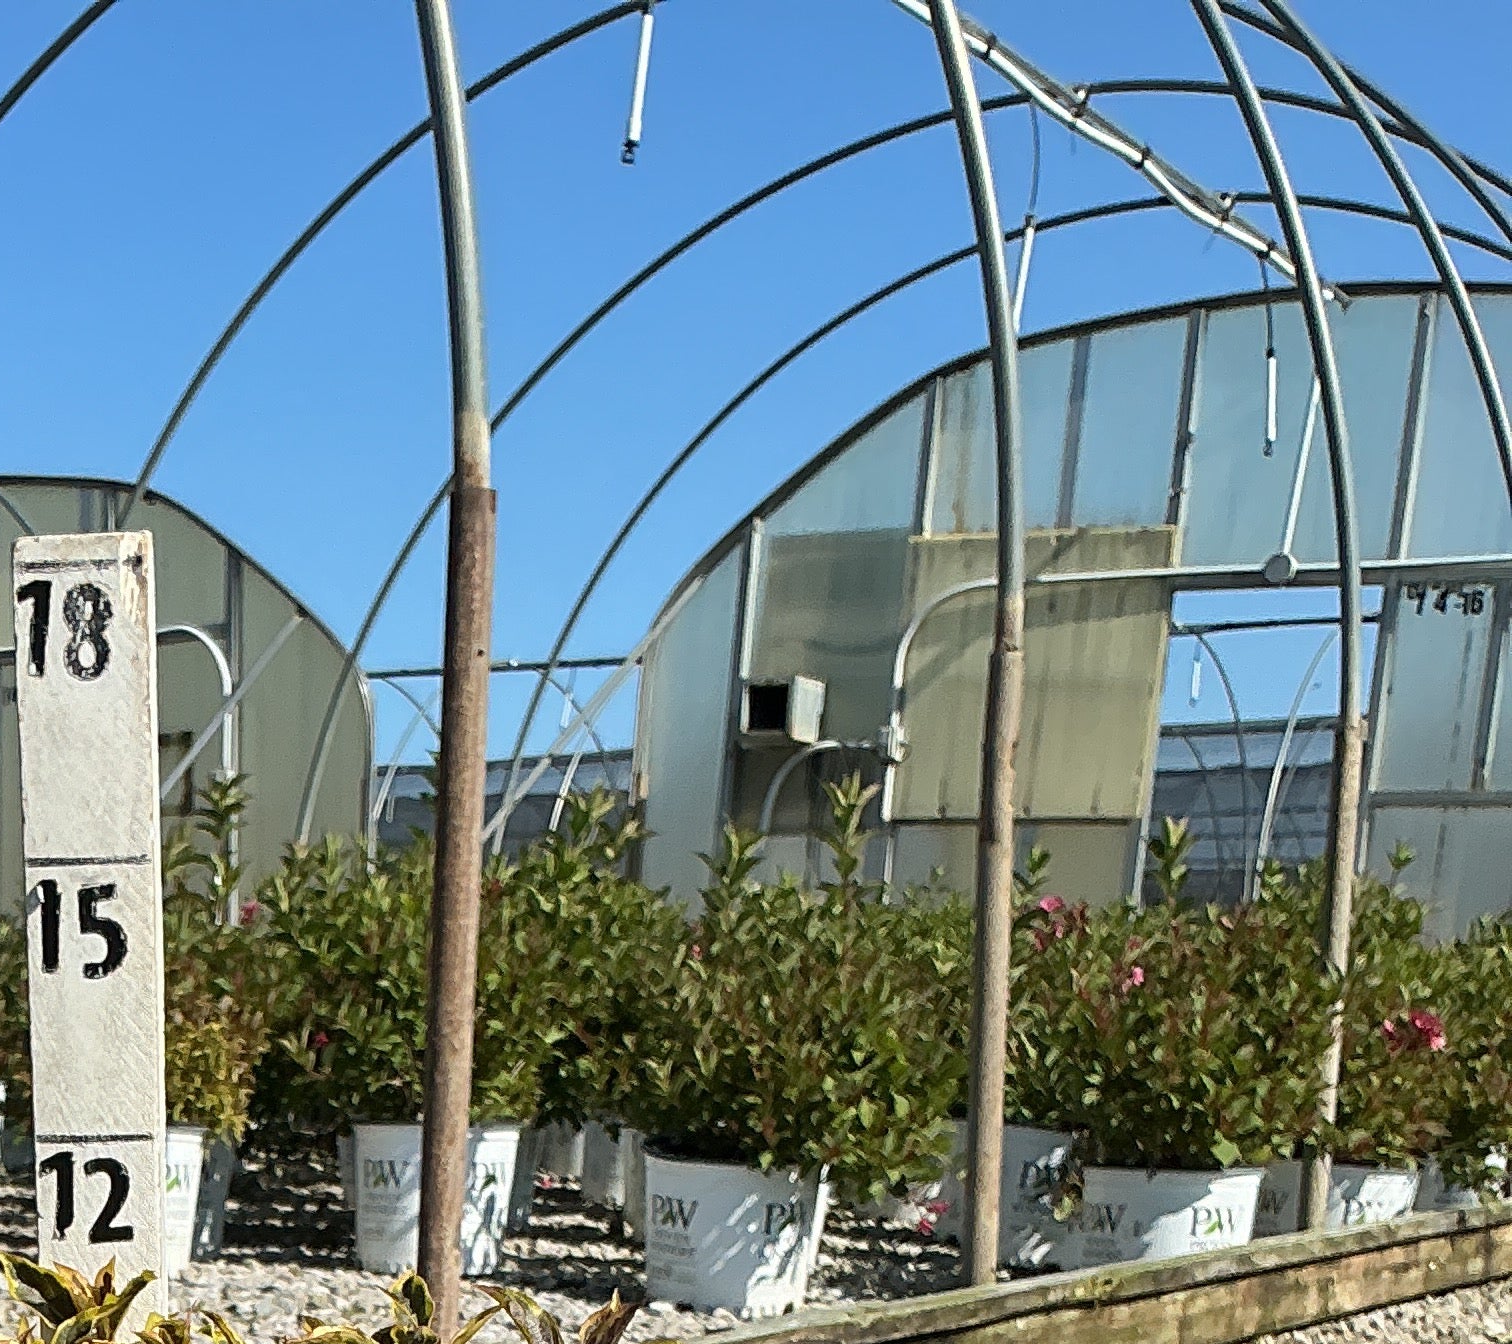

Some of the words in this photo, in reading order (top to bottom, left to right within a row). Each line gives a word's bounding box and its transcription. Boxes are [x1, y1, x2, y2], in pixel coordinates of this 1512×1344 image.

[17, 579, 114, 681] 18
[27, 878, 128, 980] 15
[39, 1150, 134, 1244] 12
